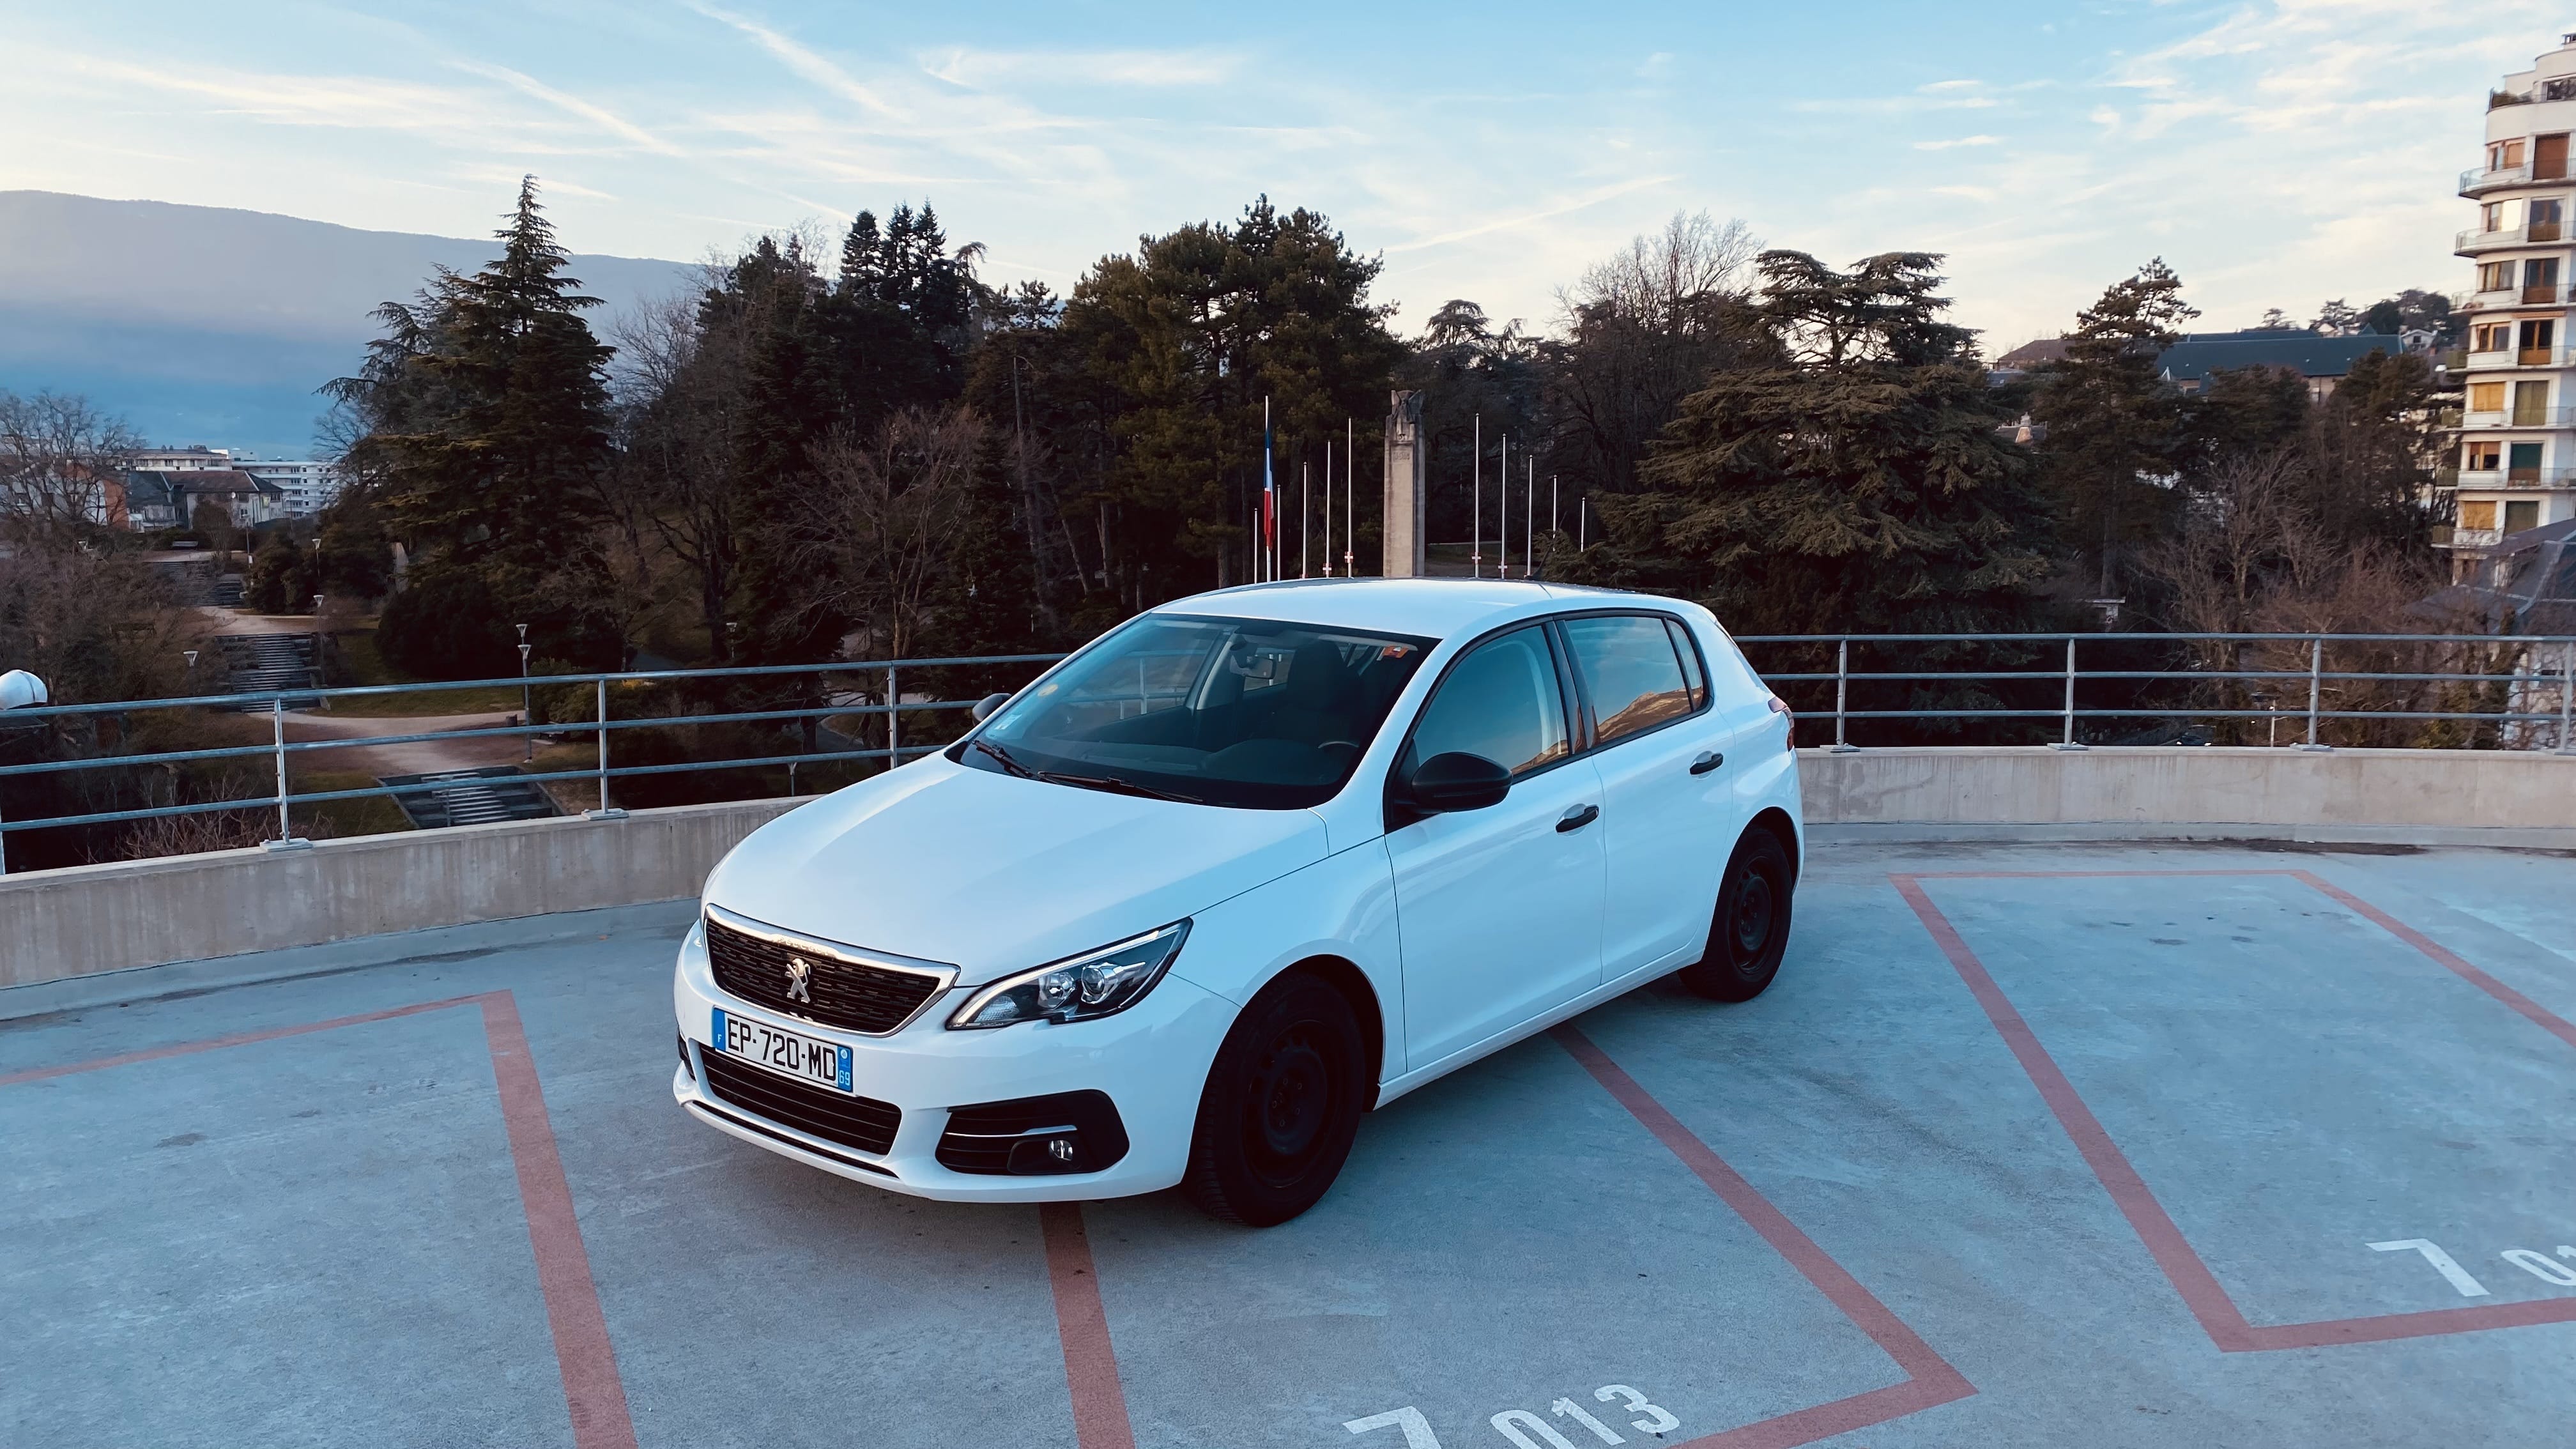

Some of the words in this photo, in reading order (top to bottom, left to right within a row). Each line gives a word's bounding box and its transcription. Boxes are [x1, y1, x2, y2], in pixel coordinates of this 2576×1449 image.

[717, 1034, 722, 1043] F
[839, 1070, 850, 1086] 69
[2365, 1238, 2490, 1297] 7
[1342, 1406, 1442, 1449] 7
[1490, 1384, 1680, 1449] 013
